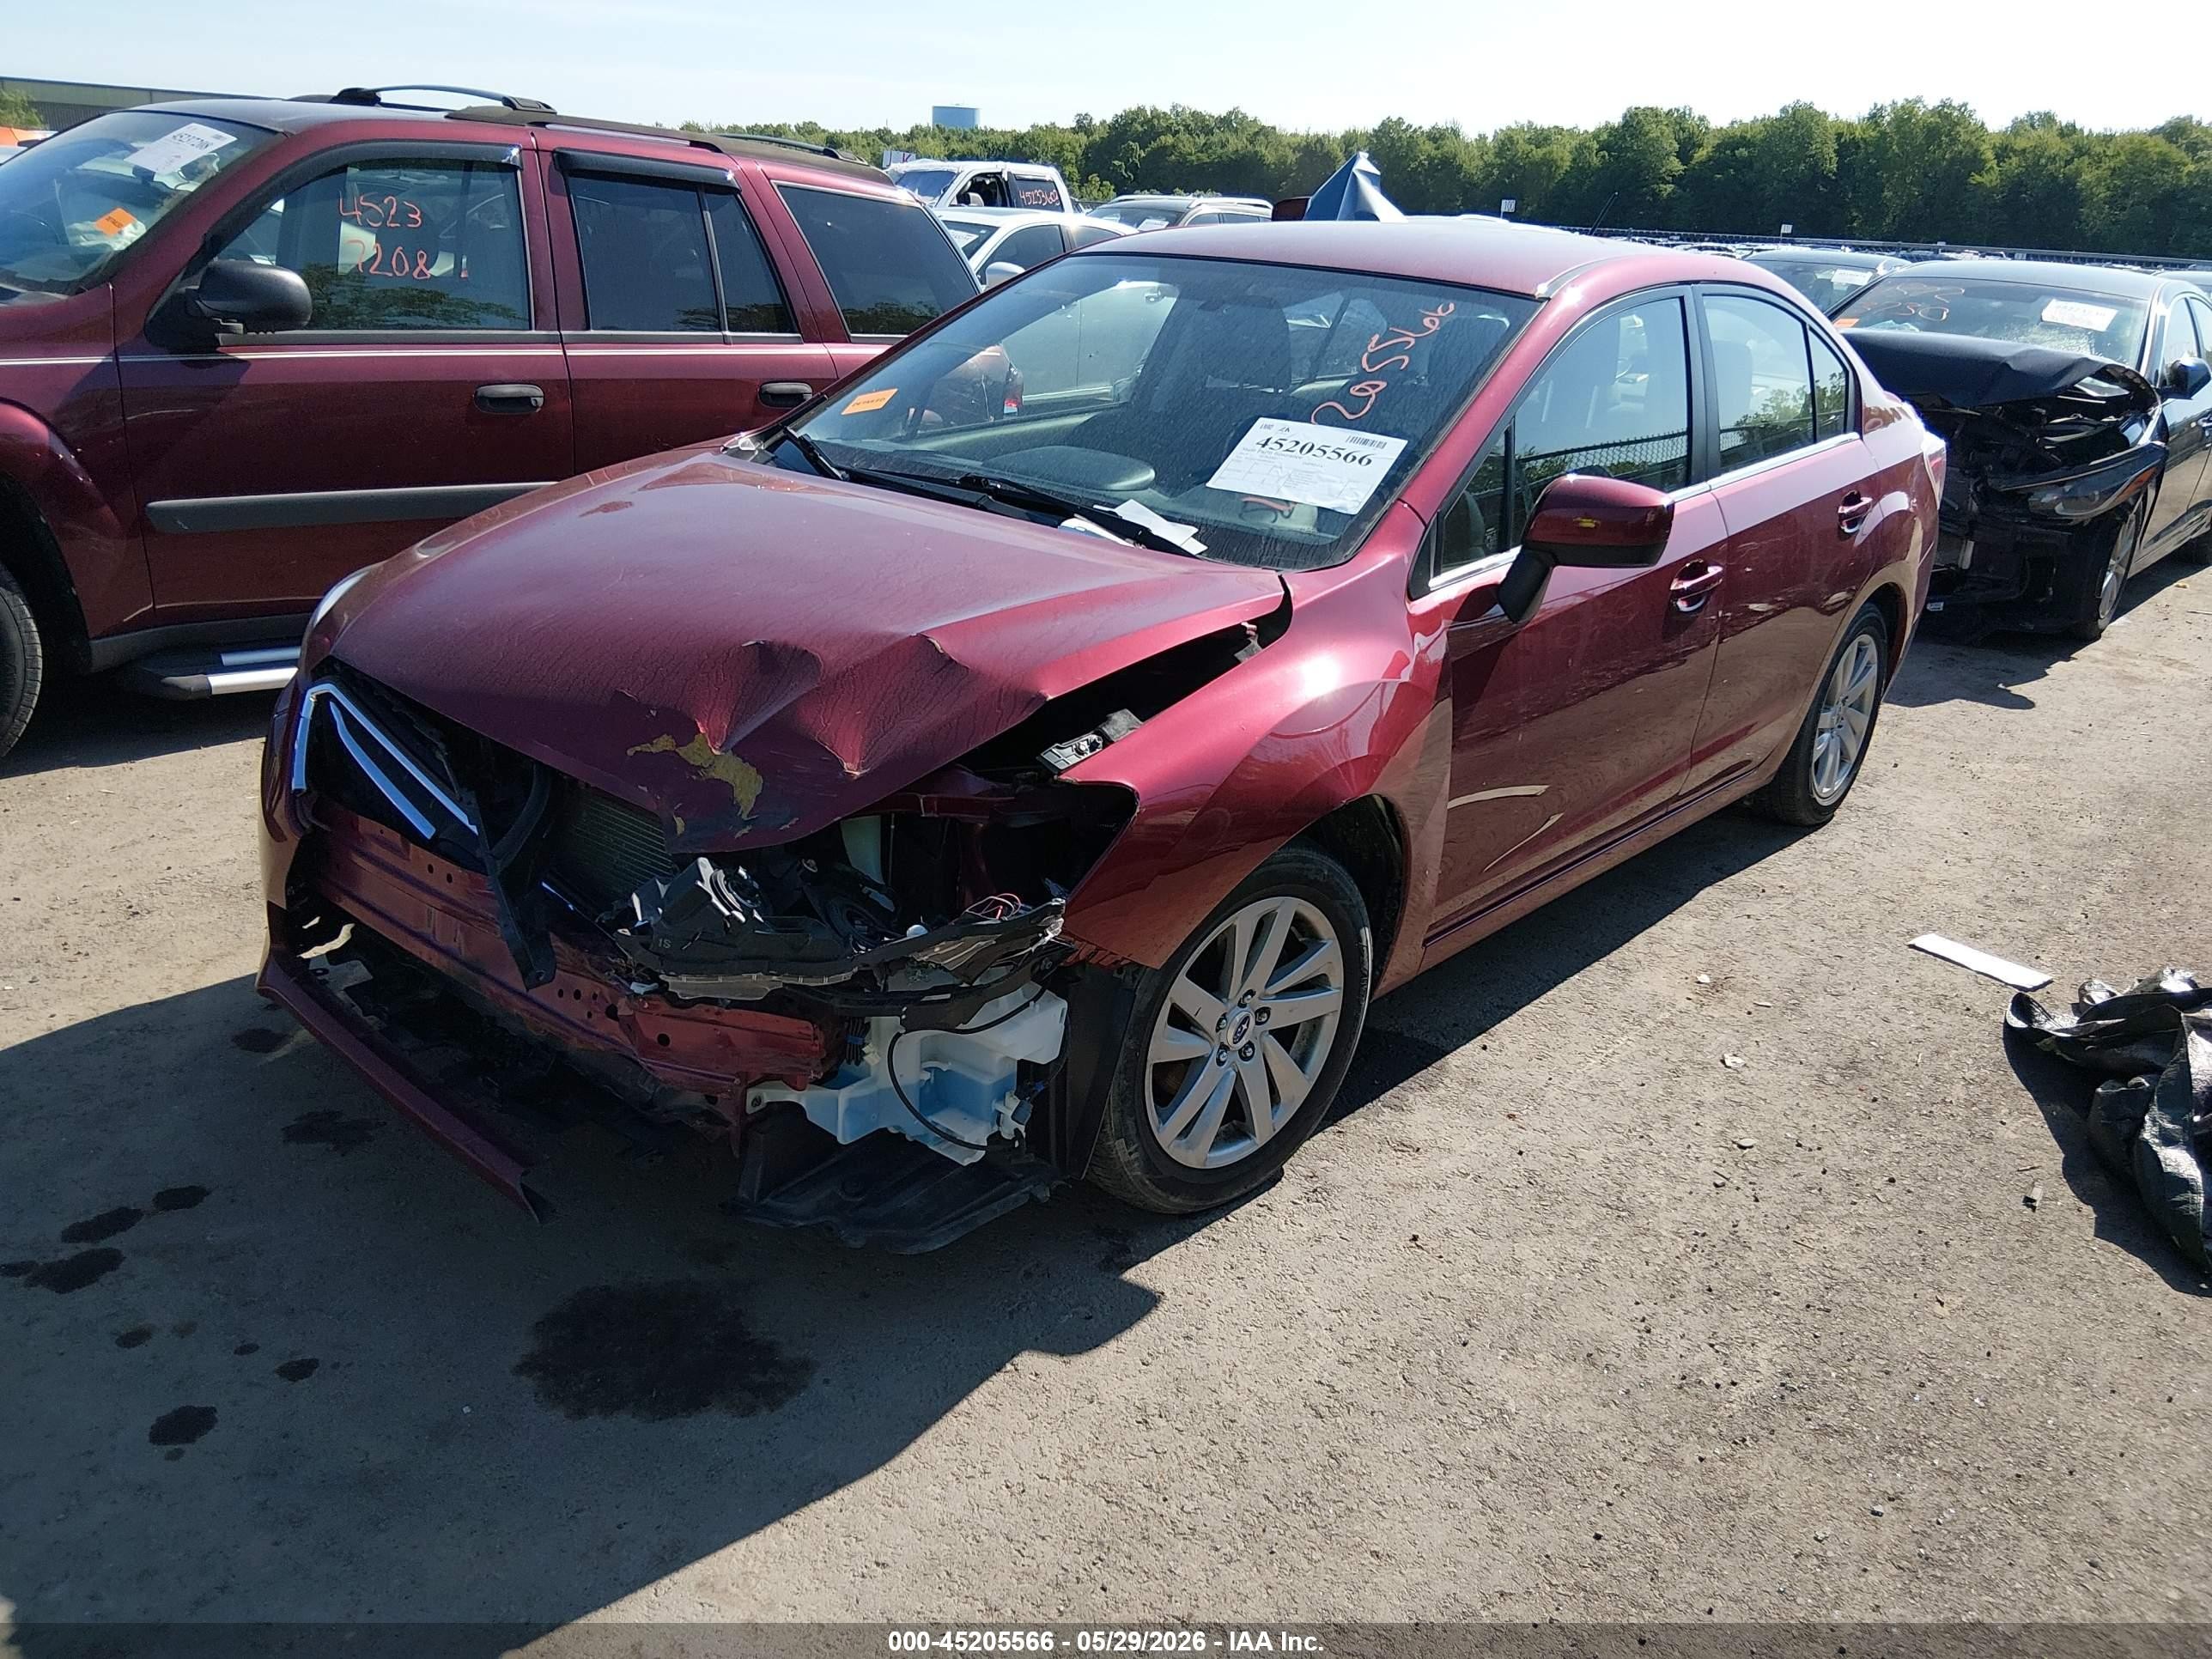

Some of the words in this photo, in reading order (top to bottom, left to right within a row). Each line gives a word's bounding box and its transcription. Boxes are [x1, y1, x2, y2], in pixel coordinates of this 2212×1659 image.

[339, 190, 422, 228] 4523
[347, 239, 431, 280] 7208
[1310, 302, 1455, 426] 205566
[1255, 436, 1375, 467] 45205566
